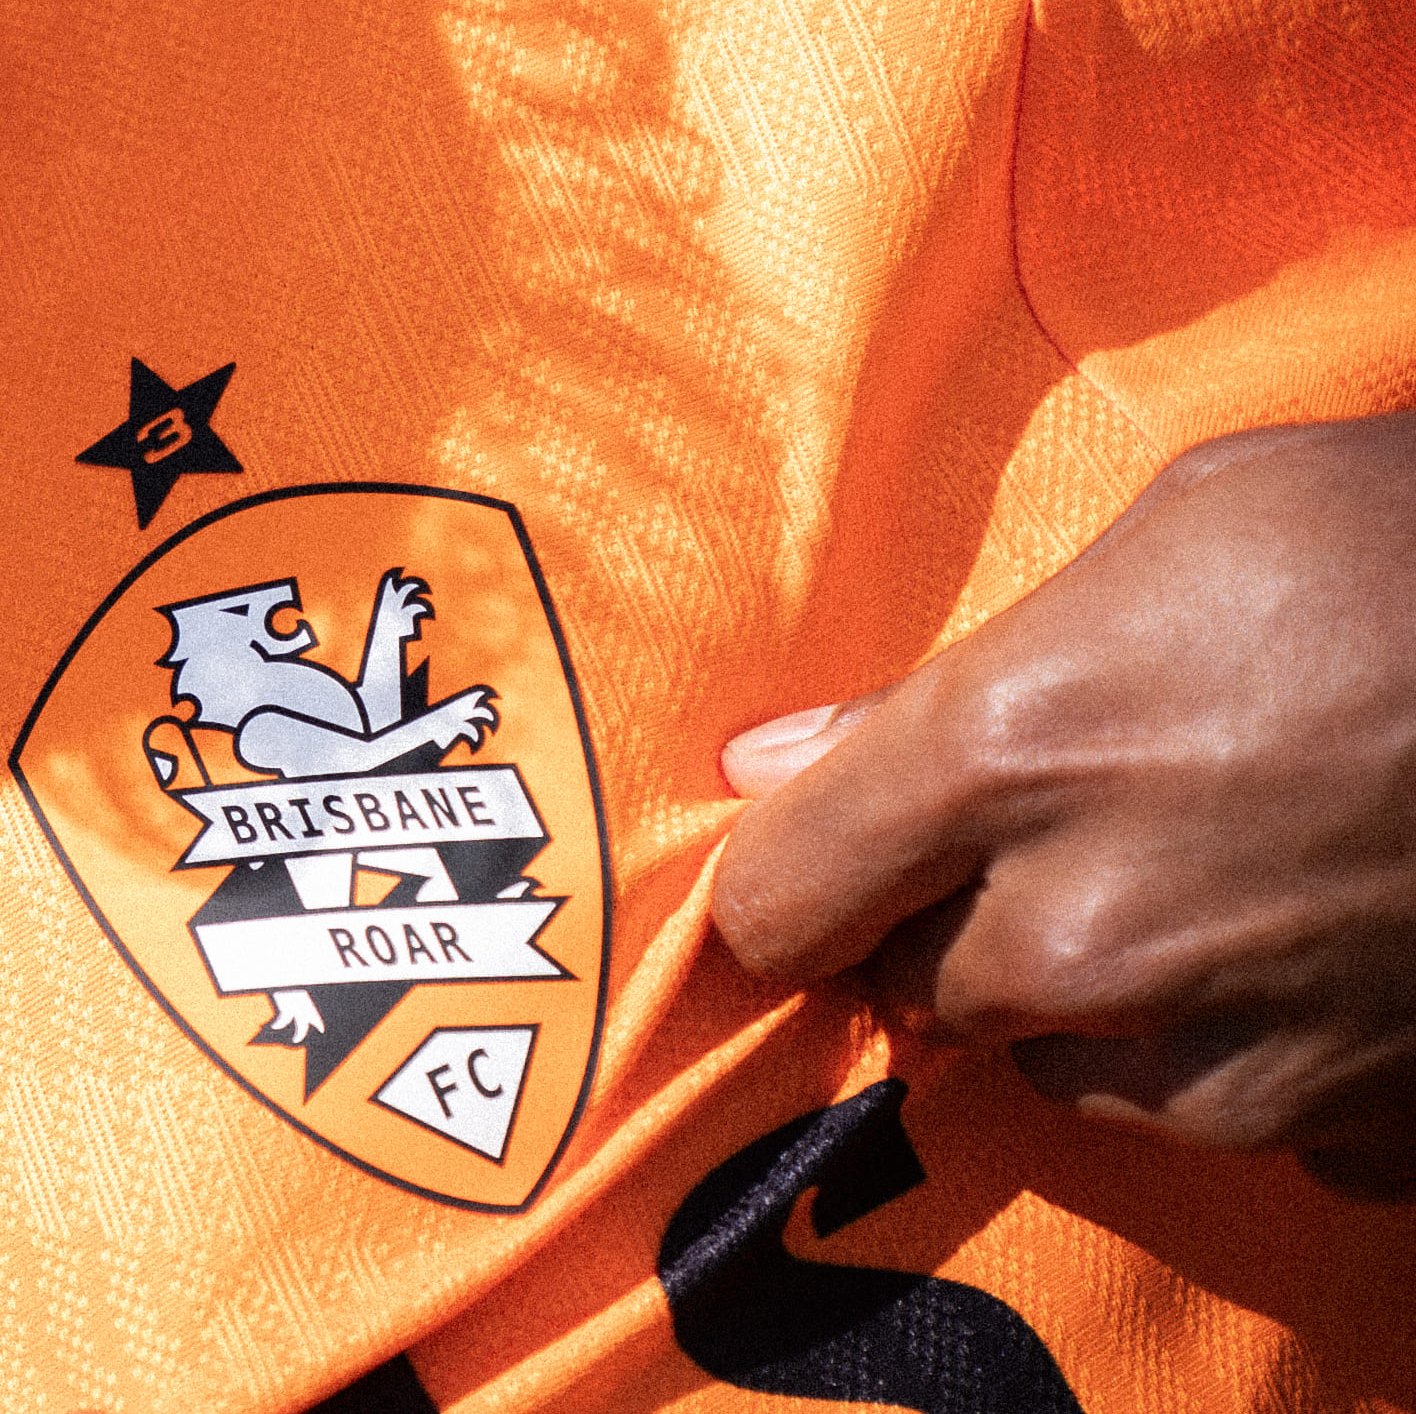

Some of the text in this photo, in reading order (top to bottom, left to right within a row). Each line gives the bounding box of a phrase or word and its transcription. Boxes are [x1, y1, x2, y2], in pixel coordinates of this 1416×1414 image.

[136, 408, 192, 463] 3
[223, 787, 496, 844] BRISBANE
[329, 923, 473, 968] ROAR
[426, 1049, 503, 1118] FC
